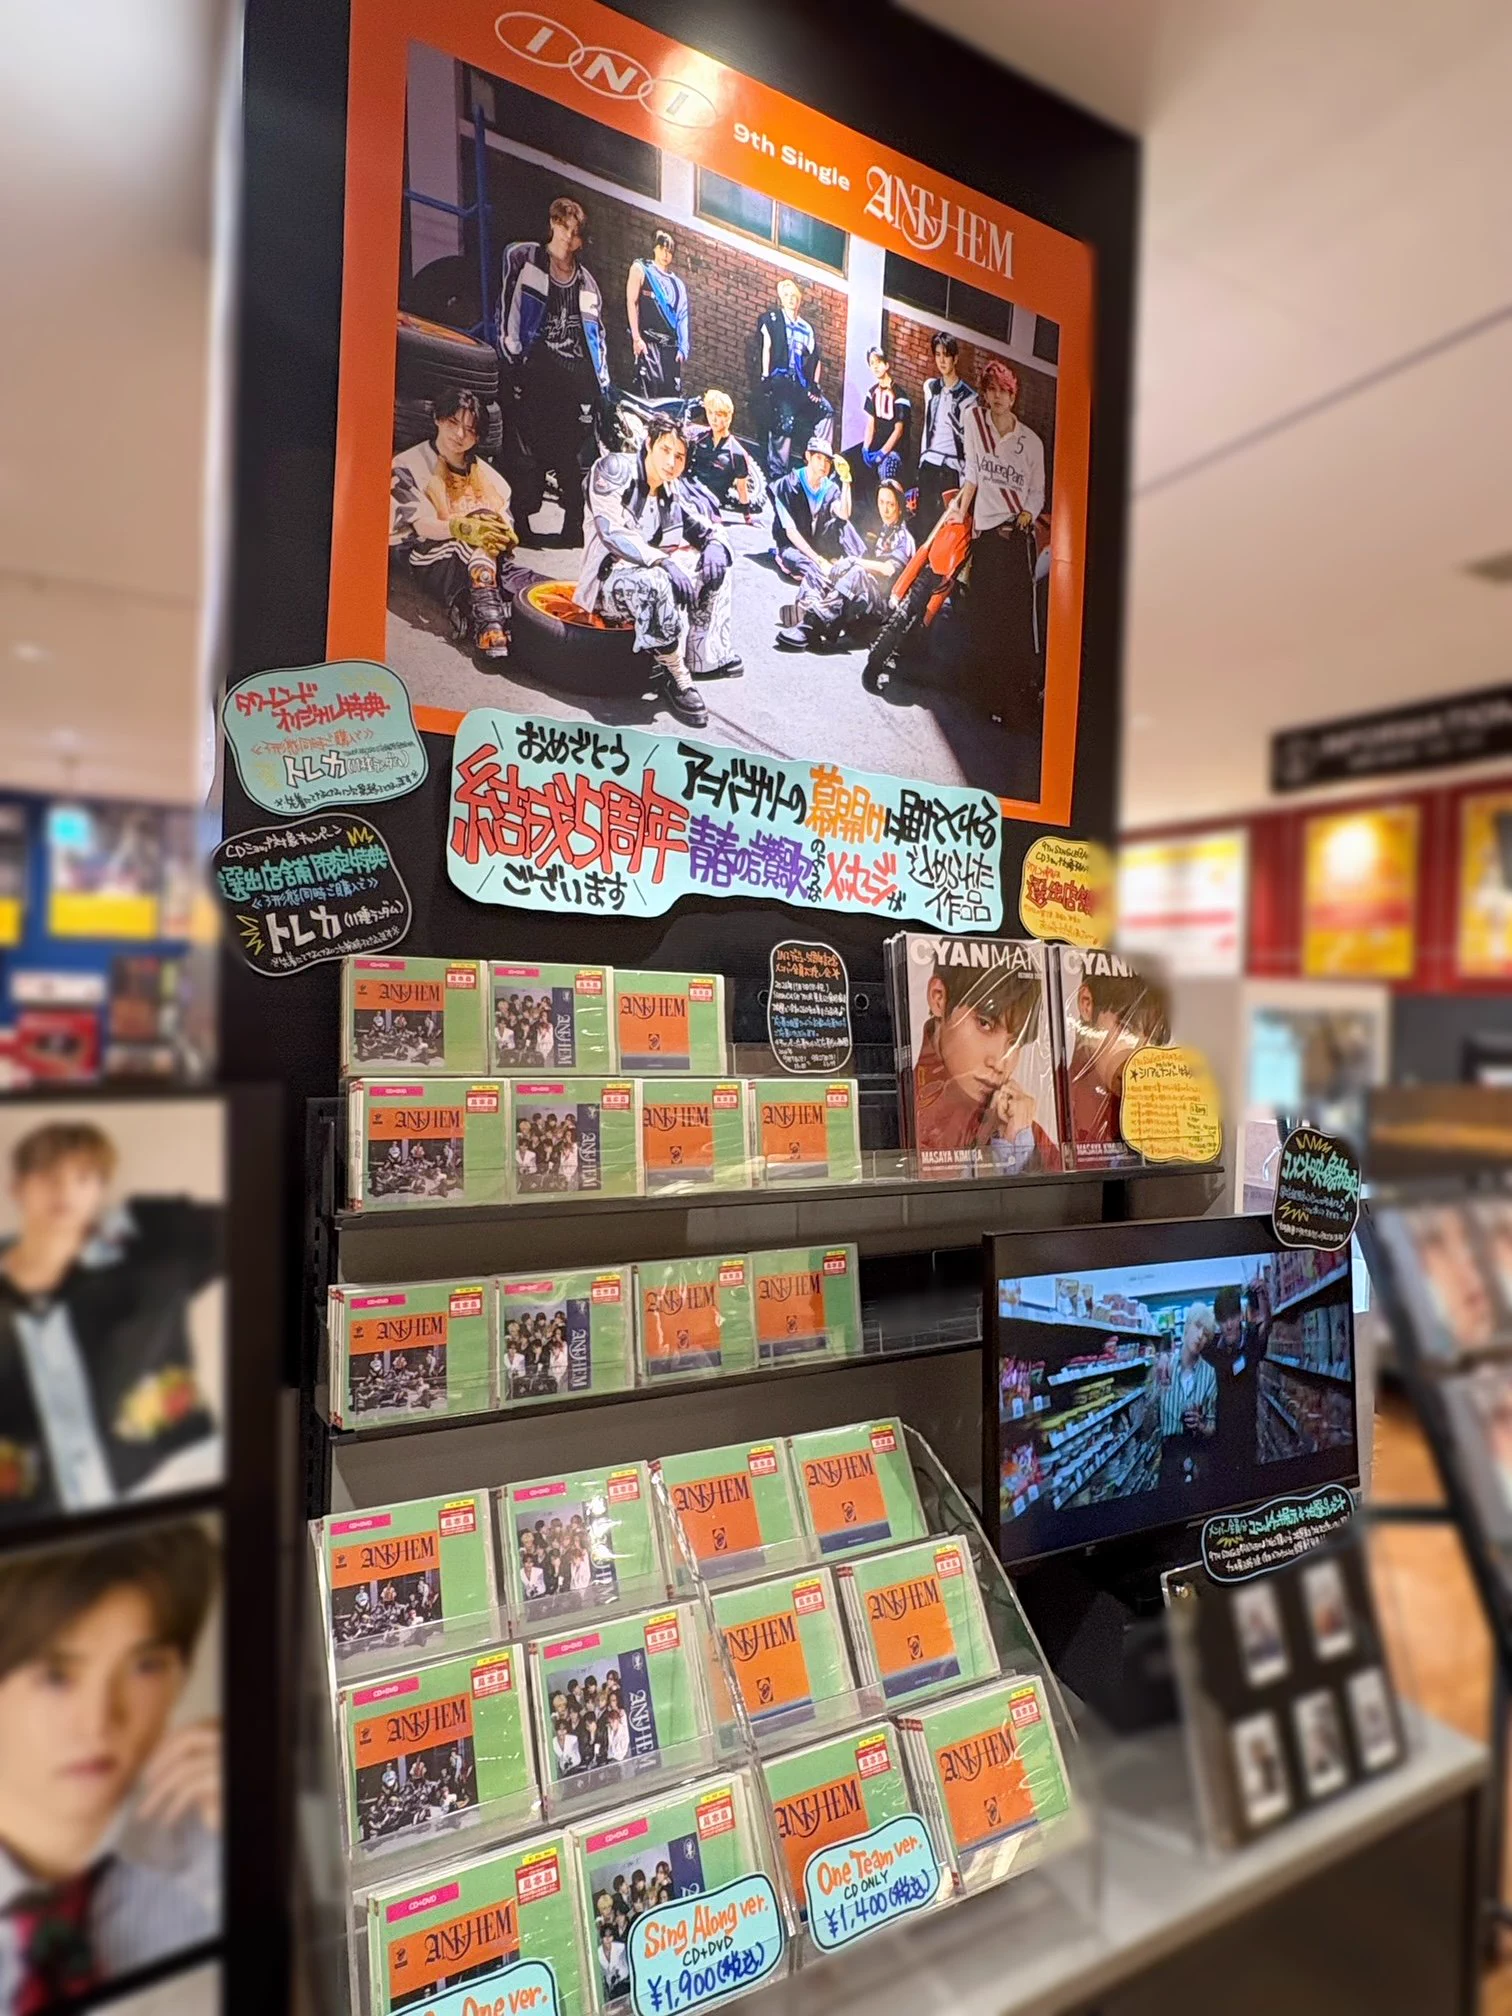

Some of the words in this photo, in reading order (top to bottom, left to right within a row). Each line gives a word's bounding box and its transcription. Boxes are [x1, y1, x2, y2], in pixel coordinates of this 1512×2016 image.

[515, 22, 700, 122] INI
[733, 122, 775, 157] 9th
[781, 143, 851, 192] Single
[864, 166, 1014, 280] ANTHEM
[1014, 435, 1027, 455] 5
[515, 721, 630, 776] おめでとう
[450, 743, 690, 885] 結成5周年
[503, 862, 628, 910] ございます
[925, 886, 992, 927] 作品
[910, 938, 1043, 973] CYANMAN
[604, 1827, 630, 1843] CD+DVD
[817, 1862, 852, 1896] One
[849, 1850, 895, 1879] Team
[894, 1835, 924, 1857] ver.
[844, 1884, 858, 1900] CD
[861, 1870, 888, 1893] ONLY
[408, 1895, 437, 1911] CD+DVD
[644, 1920, 688, 1959] Sing
[693, 1903, 738, 1944] Along
[740, 1894, 769, 1918] ver.
[682, 1936, 733, 1966] CD+DVD
[508, 1985, 548, 2014] ver.
